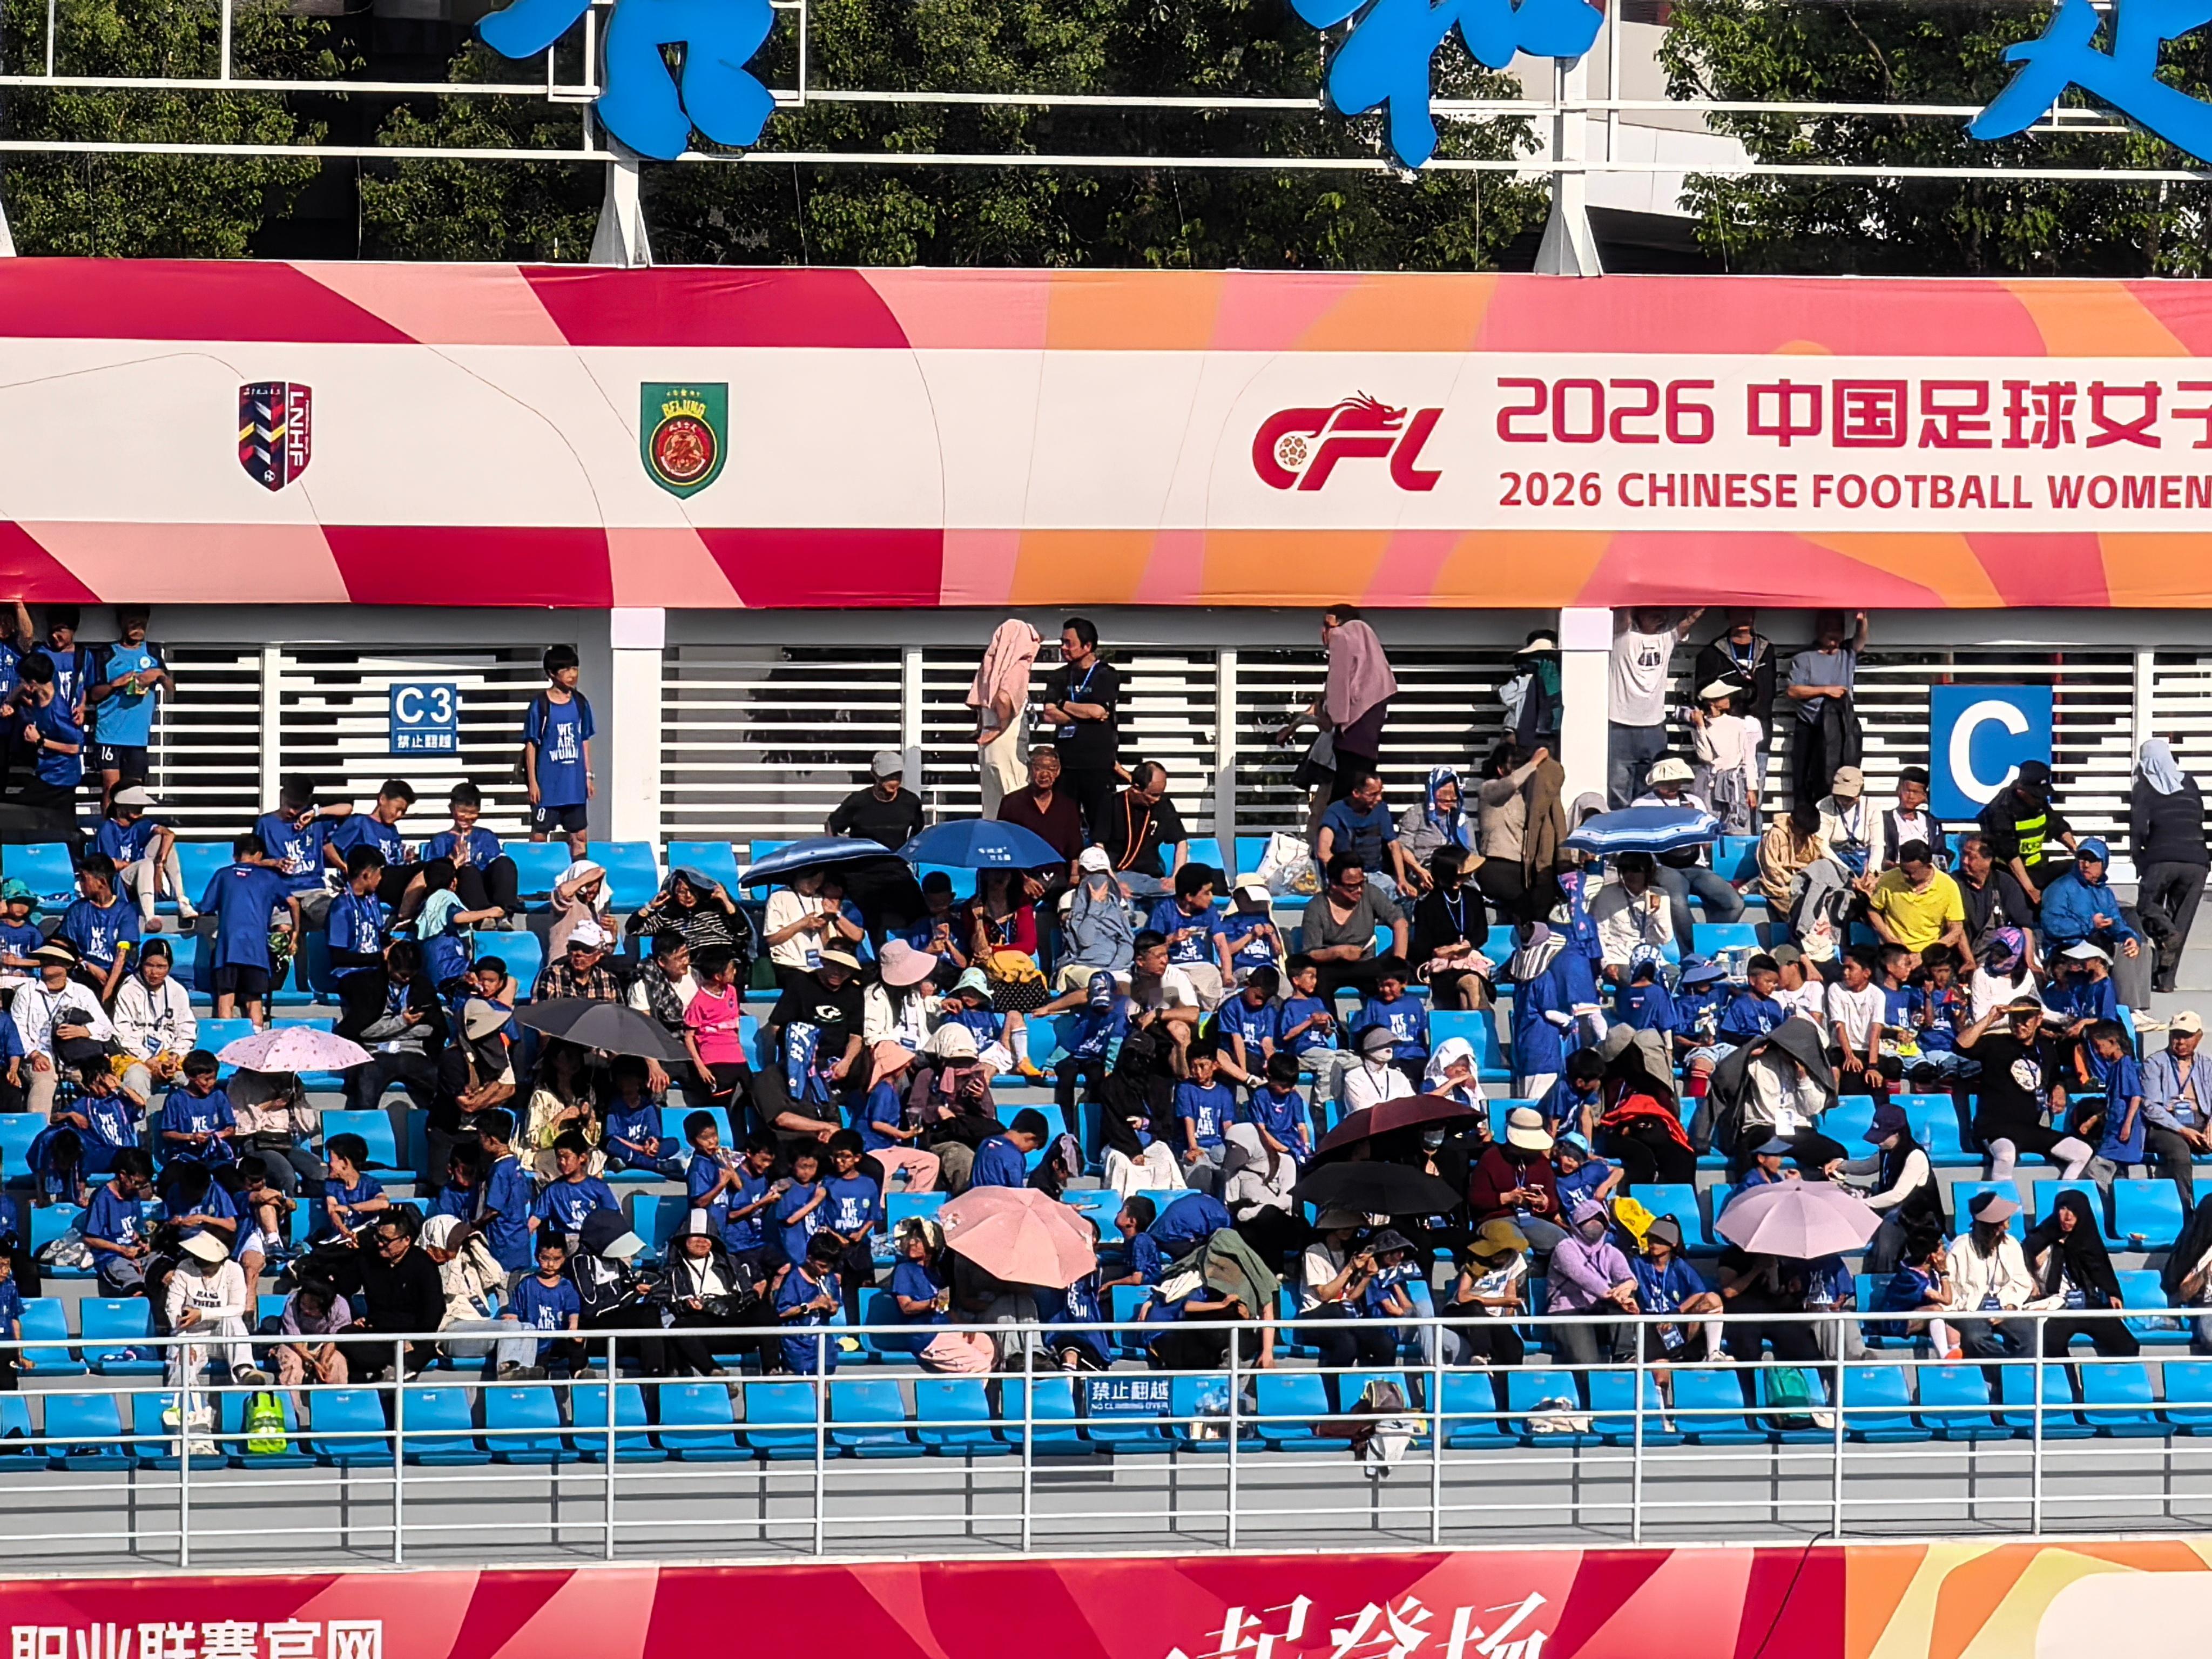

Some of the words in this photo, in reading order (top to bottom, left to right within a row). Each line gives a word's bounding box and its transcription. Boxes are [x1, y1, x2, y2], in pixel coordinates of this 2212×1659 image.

[289, 390, 304, 467] LNHF
[1496, 377, 1715, 444] 2026
[1747, 379, 2212, 449] 中国足球女子
[1500, 472, 1601, 507] 2026
[1618, 473, 1797, 508] CHINESE
[1813, 475, 2033, 509] FOOTBALL
[2047, 475, 2212, 509] WOMEN
[396, 687, 452, 723] C3
[101, 746, 114, 761] 16
[1949, 700, 2029, 805] C
